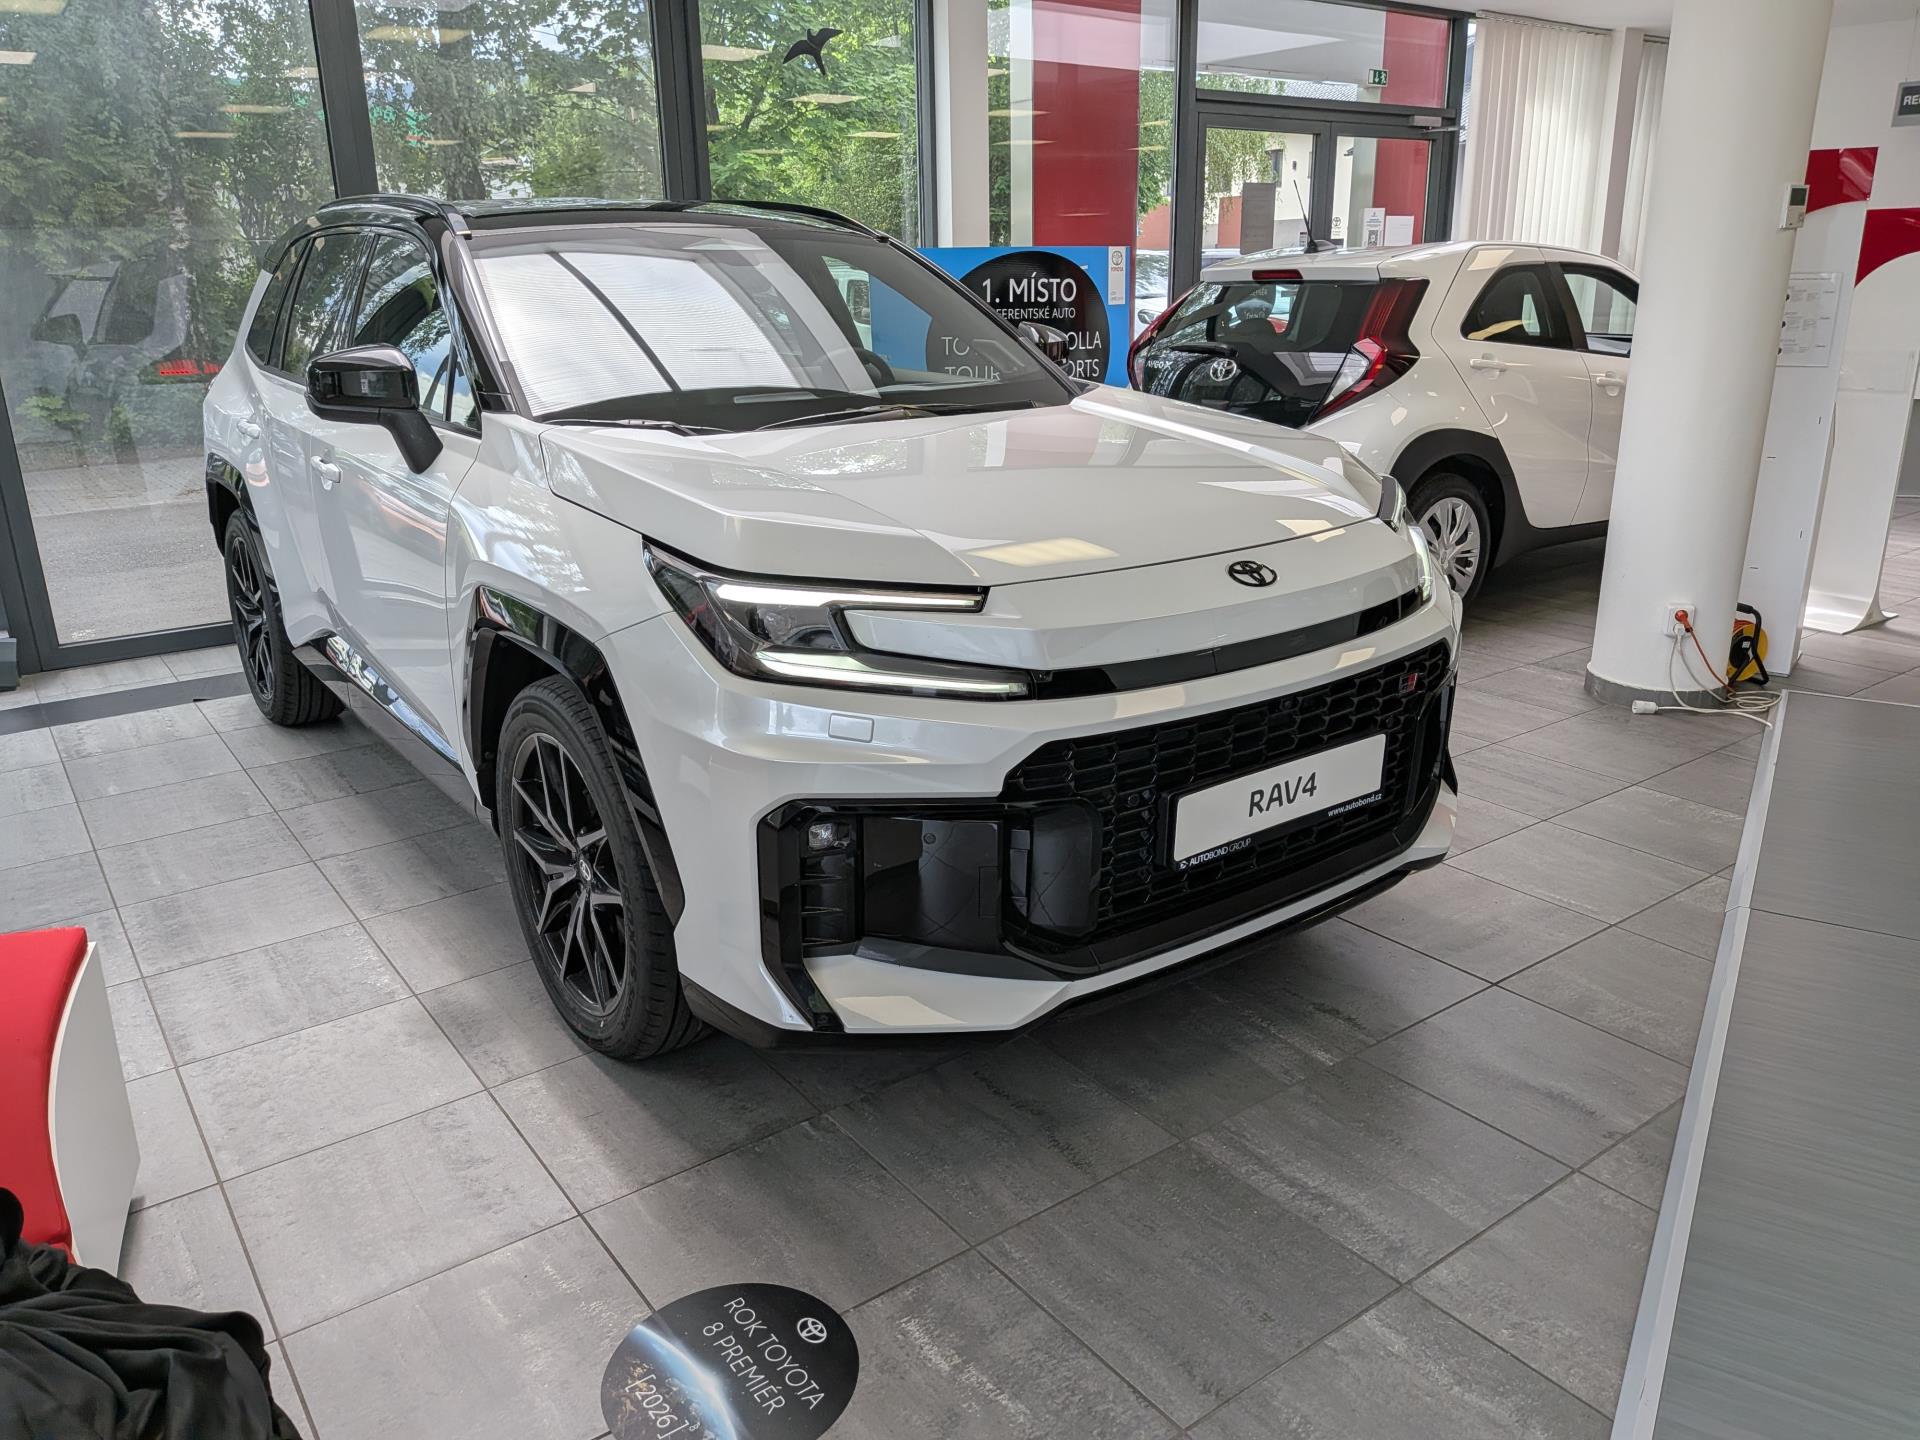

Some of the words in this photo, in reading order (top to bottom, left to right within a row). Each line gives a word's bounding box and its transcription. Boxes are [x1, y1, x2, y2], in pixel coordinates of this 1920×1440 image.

[1903, 94, 1920, 106] RE
[982, 278, 1000, 303] 1.
[1009, 272, 1077, 303] MÍSTO
[996, 306, 1050, 320] FERENTSKÉ
[1052, 307, 1076, 319] AUTO
[1066, 331, 1102, 350] OLLA
[1068, 359, 1100, 378] ORTS
[1248, 771, 1318, 818] RAV4
[1327, 793, 1382, 817] www.autobond.cz
[1189, 846, 1228, 867] AUTOBOND
[1229, 837, 1252, 853] GROUP
[723, 1297, 767, 1338] ROK
[757, 1333, 825, 1410] TOYOTA
[702, 1321, 724, 1337] 8
[713, 1335, 786, 1416] PREMIÉR
